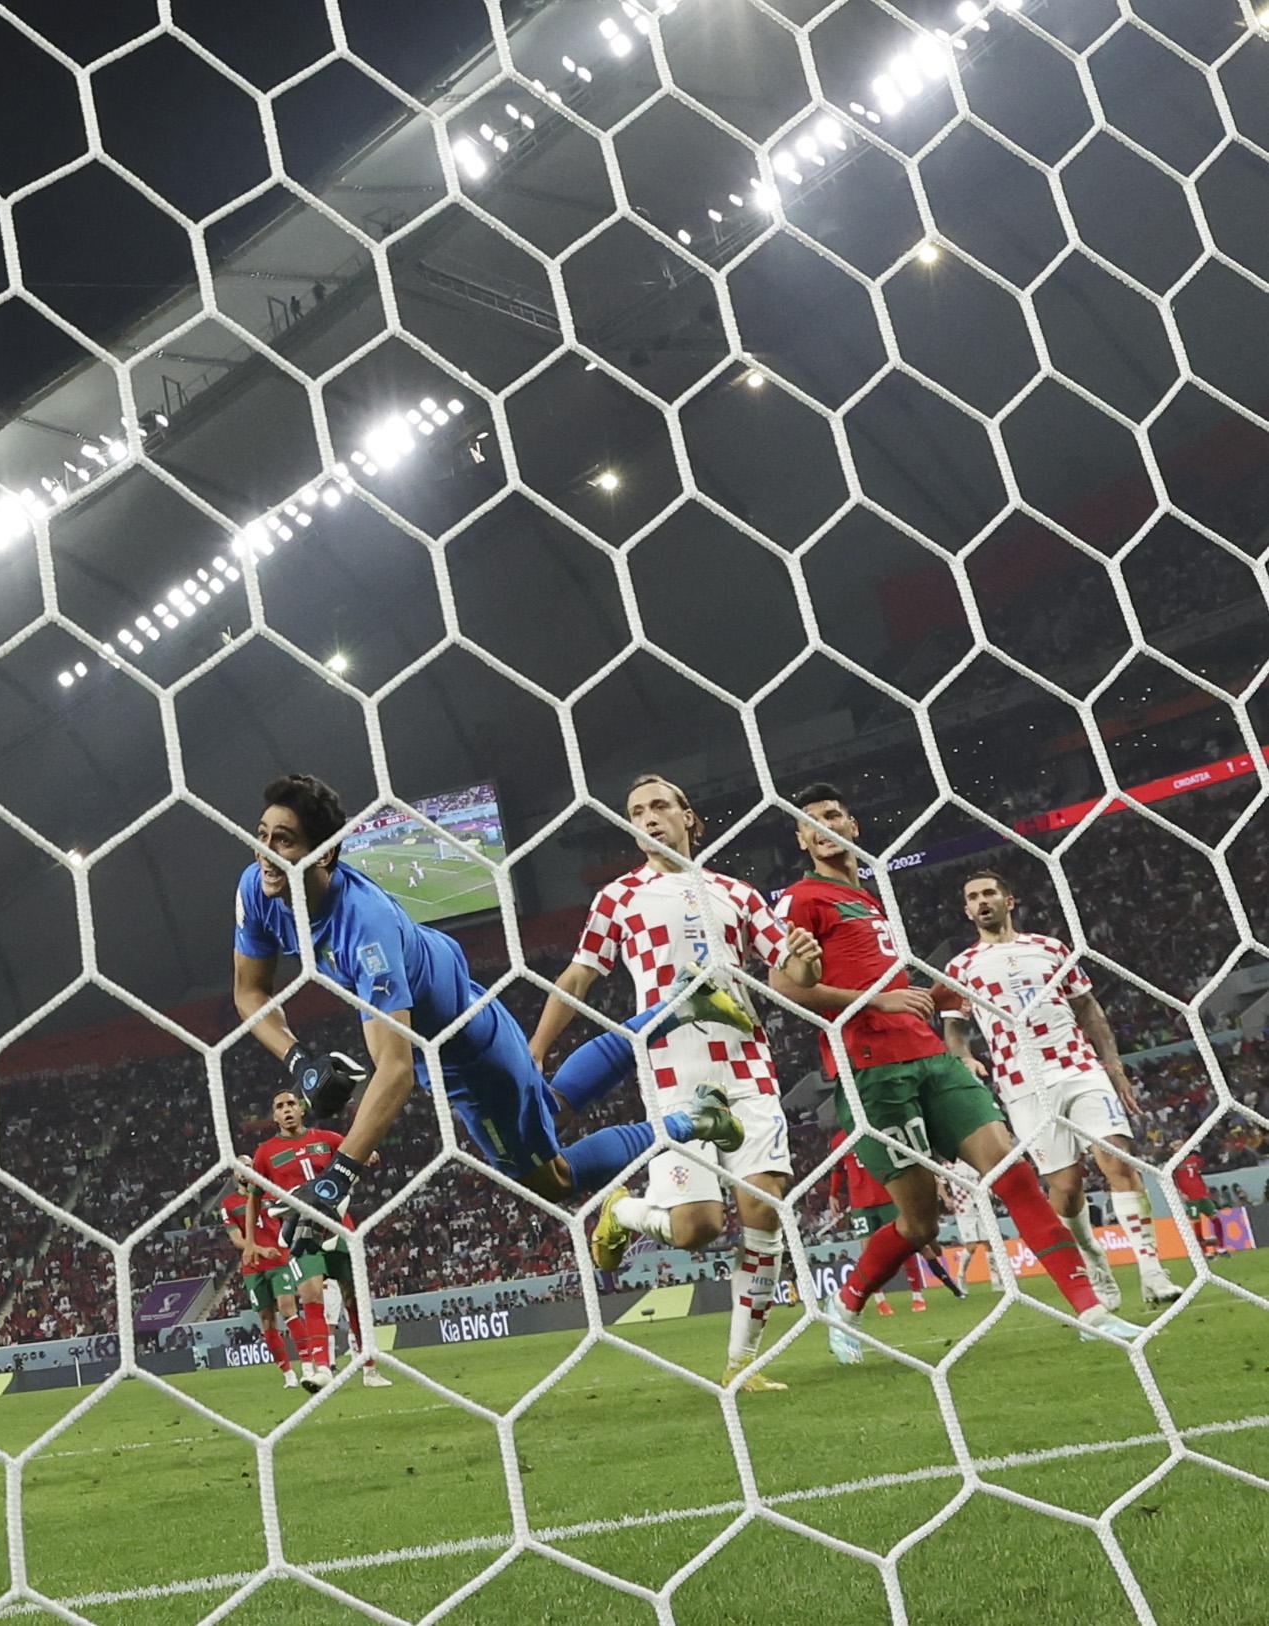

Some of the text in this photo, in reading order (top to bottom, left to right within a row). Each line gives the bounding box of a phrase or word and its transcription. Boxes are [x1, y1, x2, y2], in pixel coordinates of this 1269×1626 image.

[881, 1116, 932, 1169] 20
[299, 1157, 316, 1181] 11
[440, 1310, 510, 1344] Kia EV6 GT
[224, 1347, 241, 1367] Kia
[240, 1343, 261, 1366] EV6
